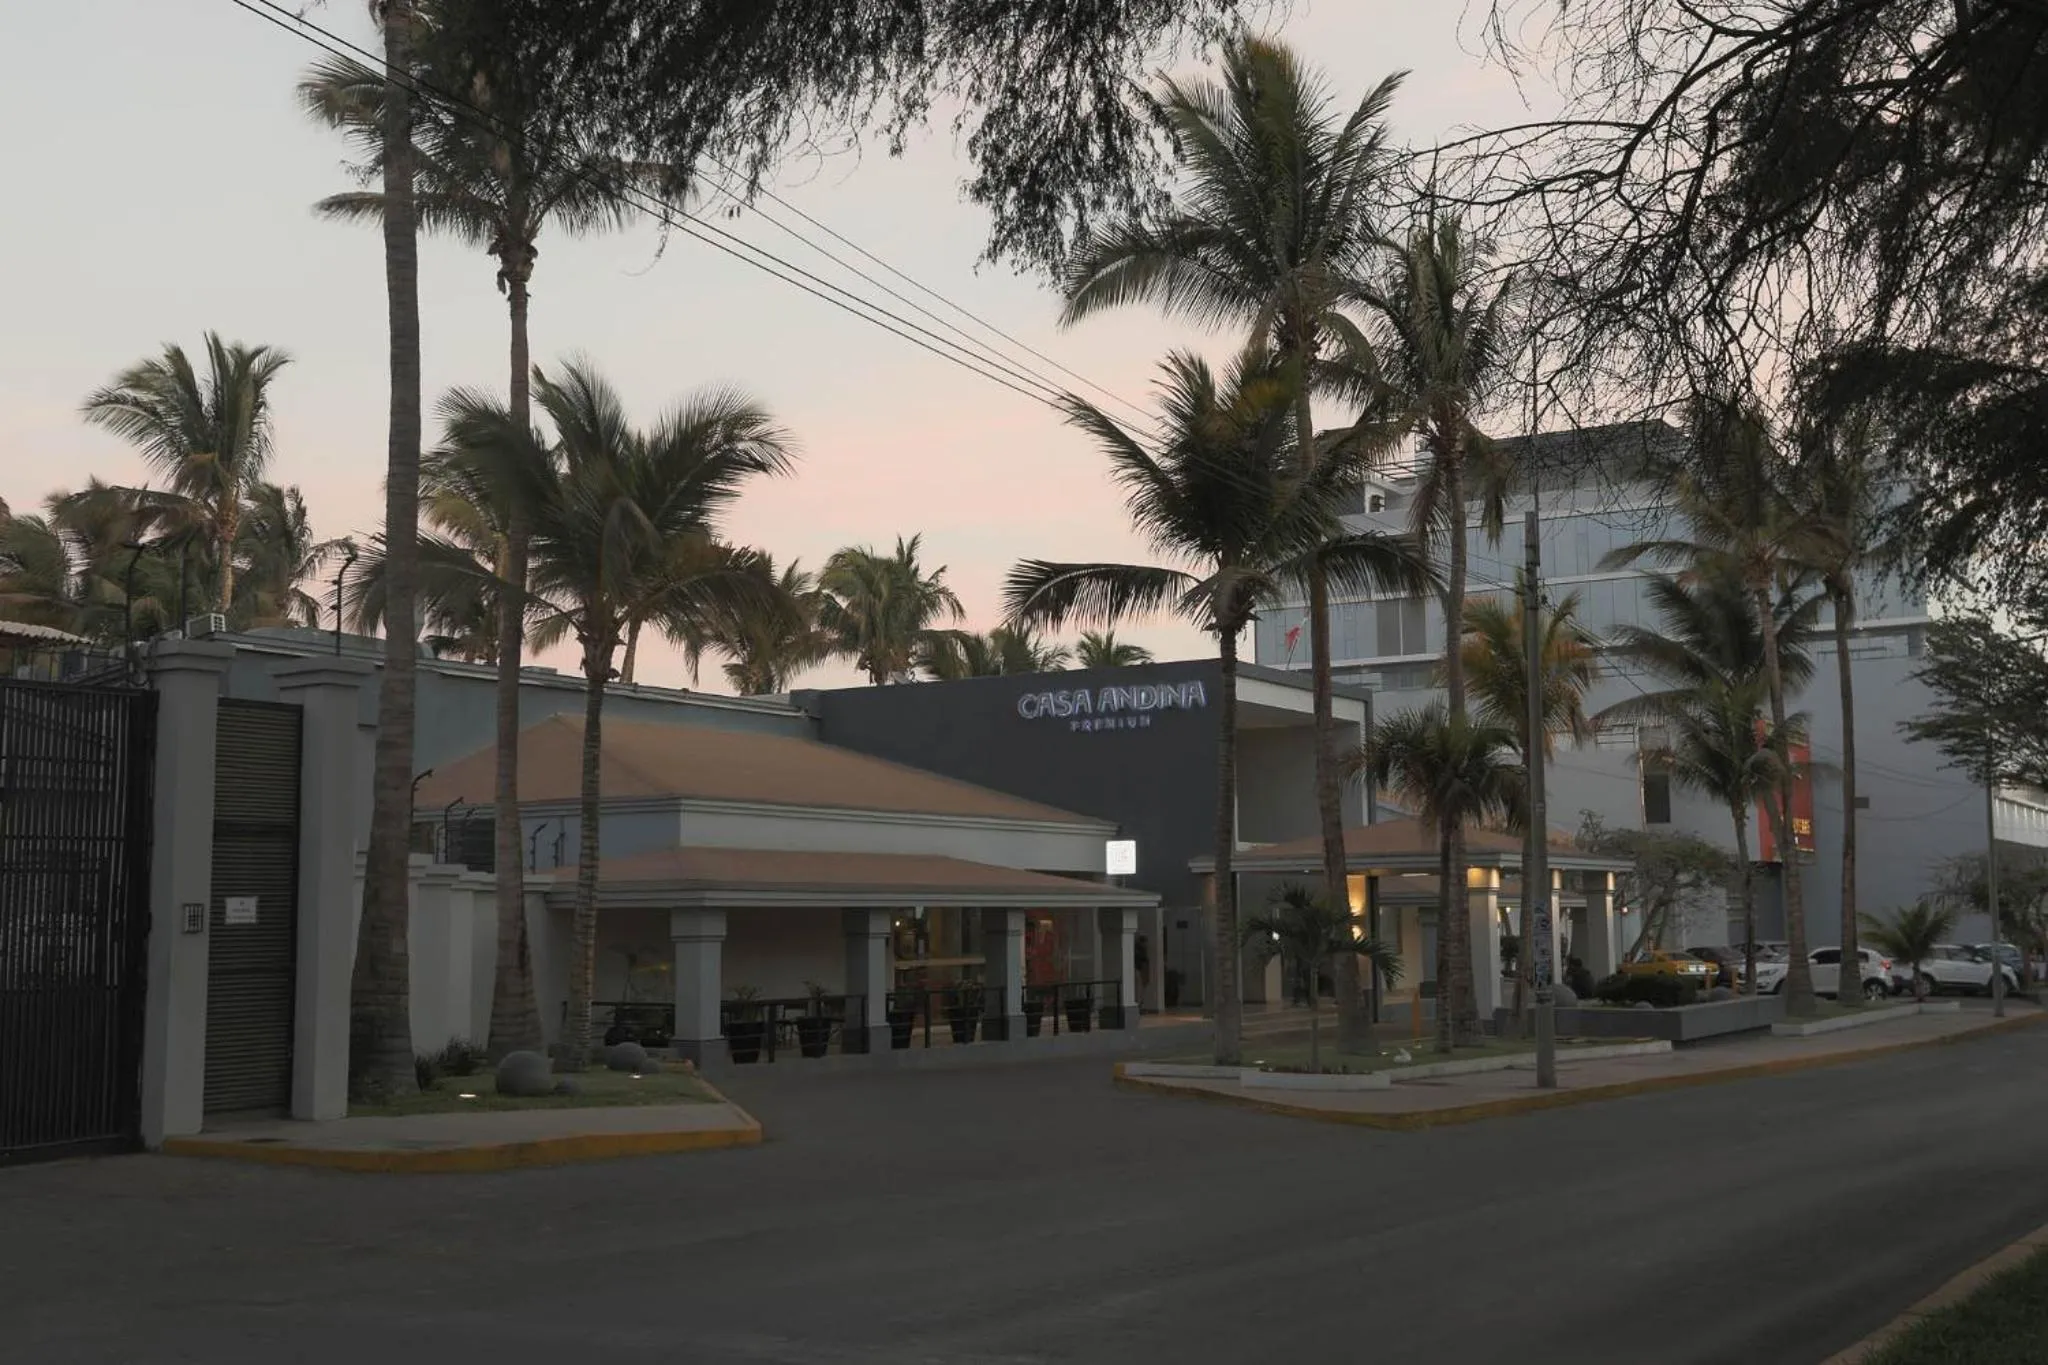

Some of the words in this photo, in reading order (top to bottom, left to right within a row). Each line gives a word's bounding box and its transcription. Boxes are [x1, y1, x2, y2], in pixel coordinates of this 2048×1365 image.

[1018, 689, 1092, 719] CASA
[1098, 680, 1206, 713] ANDINA
[1070, 715, 1151, 733] PREMIUM
